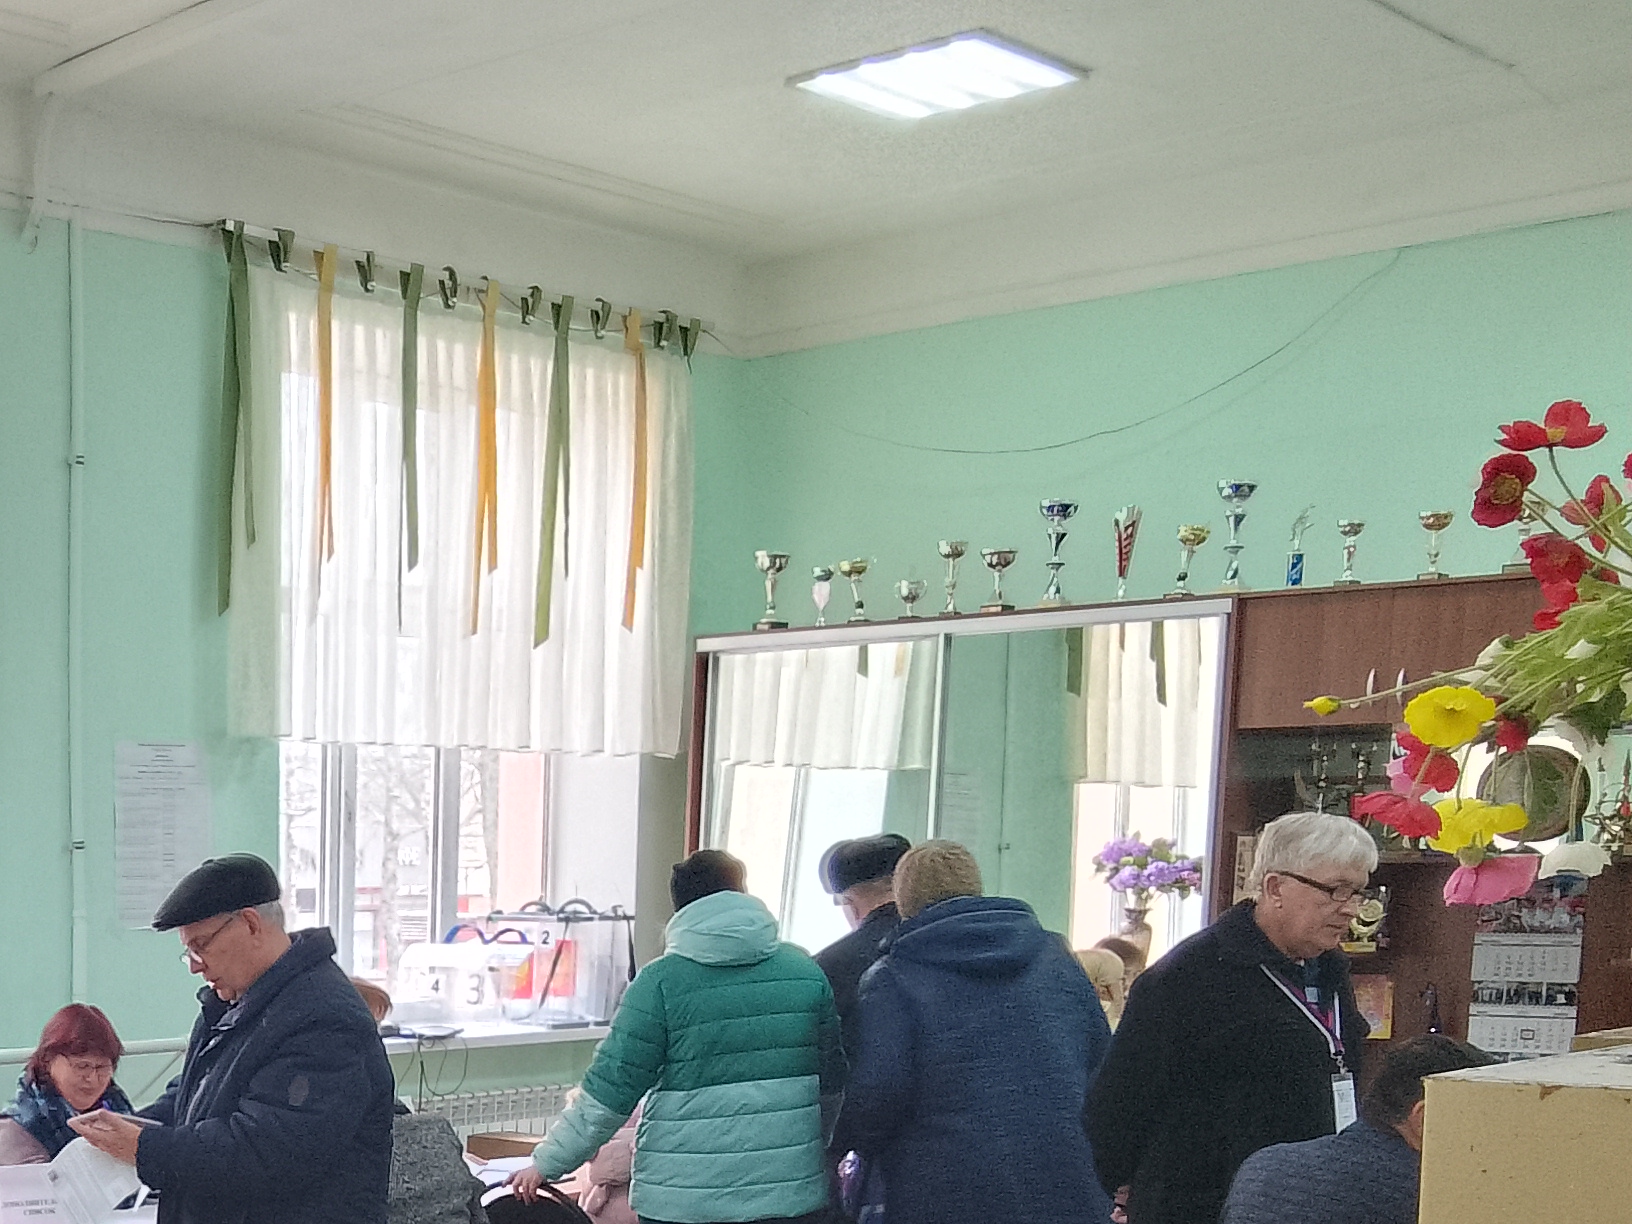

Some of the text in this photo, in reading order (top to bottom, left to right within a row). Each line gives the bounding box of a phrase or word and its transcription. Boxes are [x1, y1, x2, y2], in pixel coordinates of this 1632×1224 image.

[541, 930, 551, 945] 2
[431, 978, 440, 994] 4
[467, 974, 484, 1005] 3
